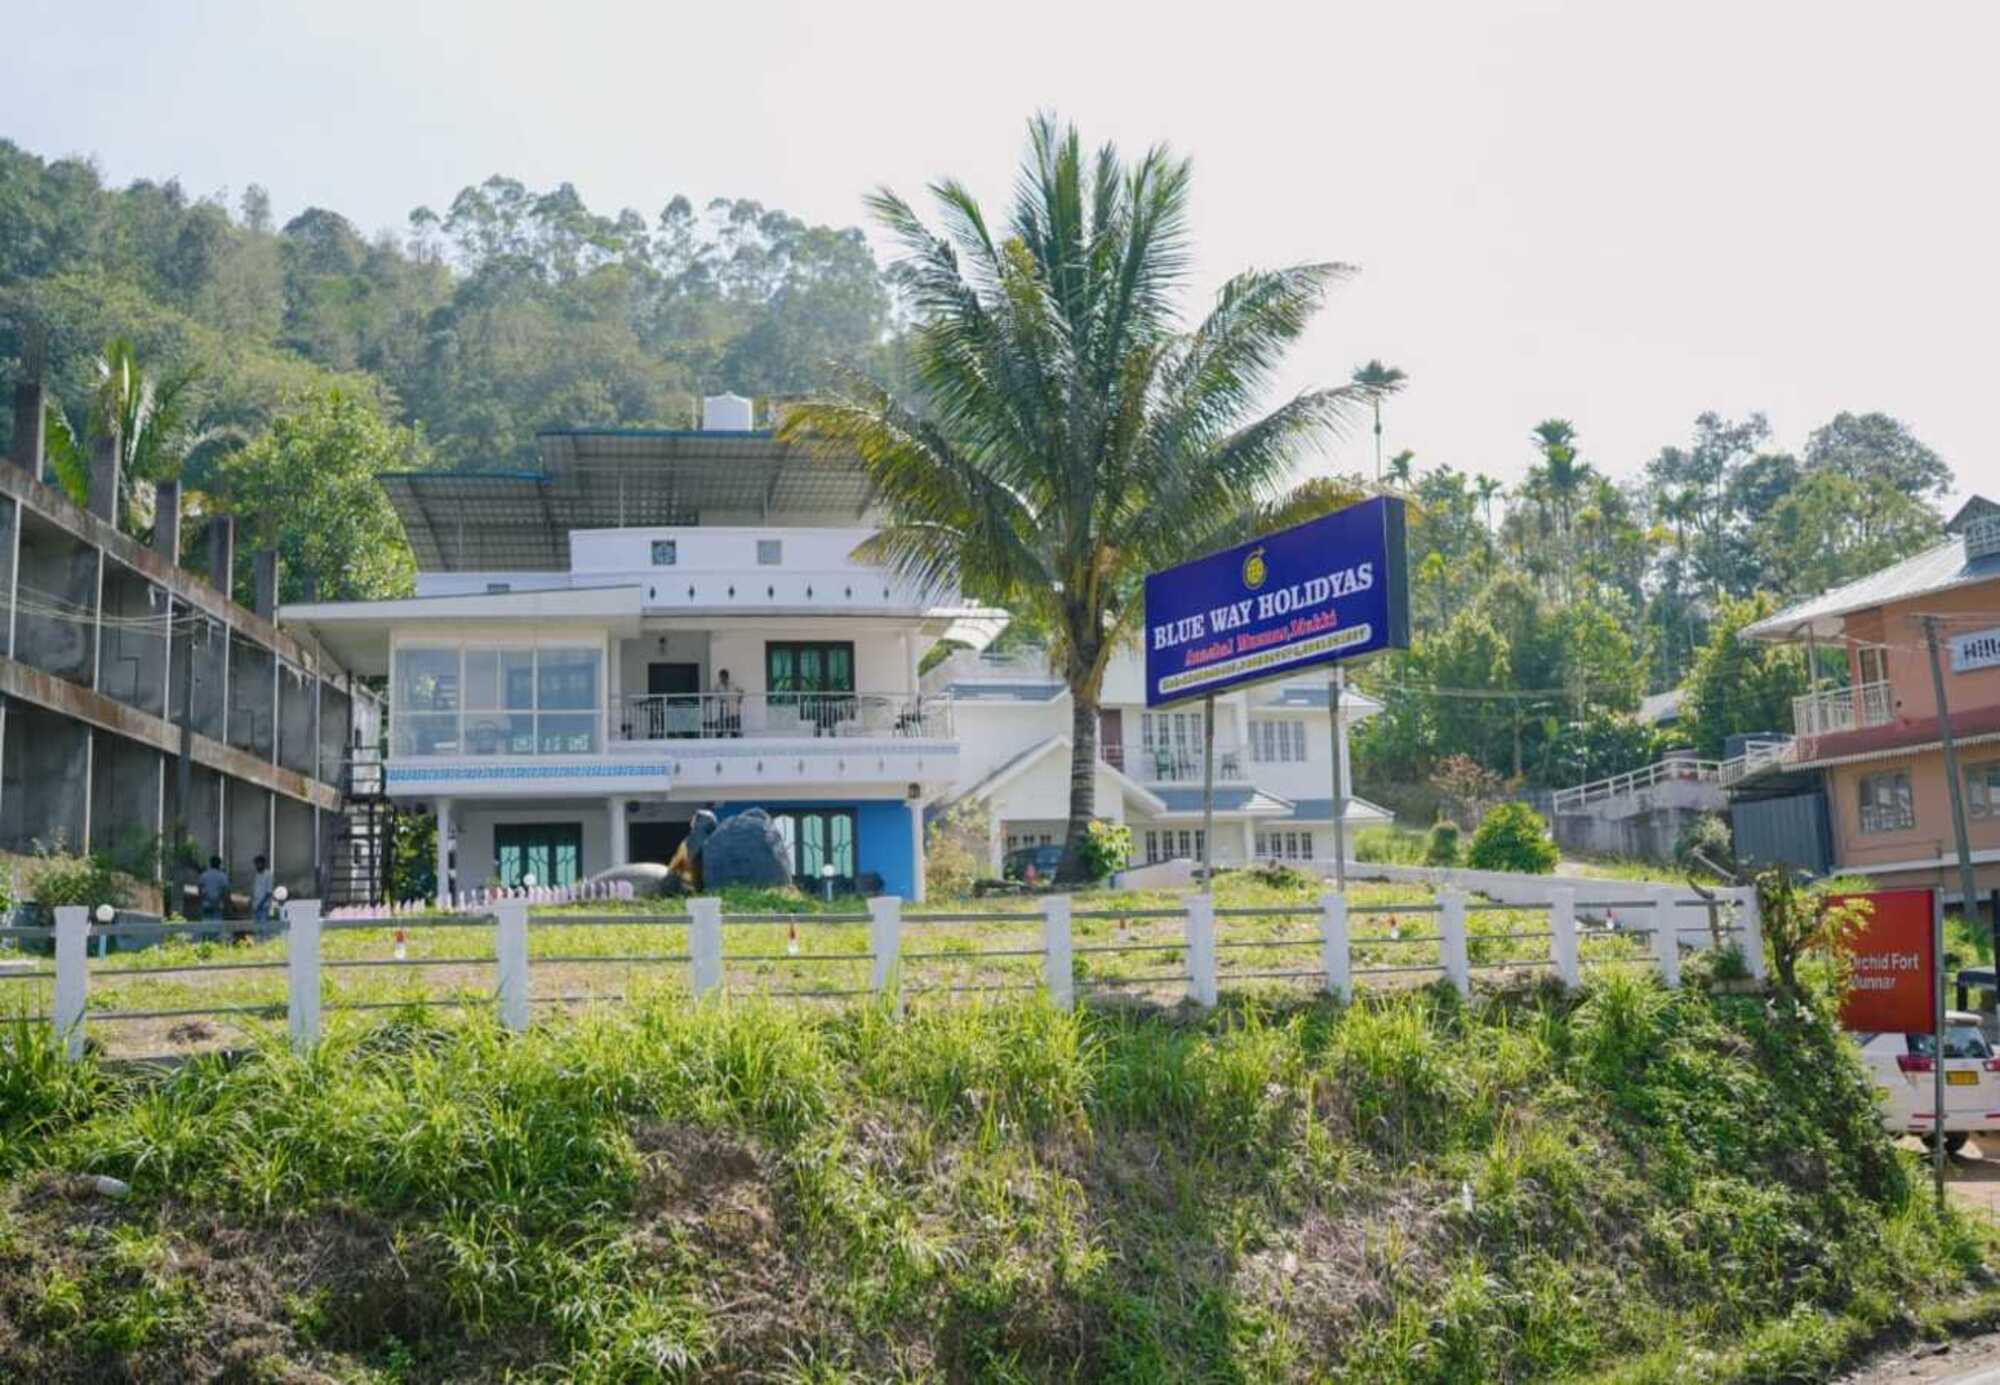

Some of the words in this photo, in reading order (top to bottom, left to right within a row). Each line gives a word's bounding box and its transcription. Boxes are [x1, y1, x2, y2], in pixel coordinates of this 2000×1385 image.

[1154, 614, 1205, 650] BLUE
[1210, 601, 1253, 634] WAY
[1257, 563, 1373, 619] HOLIDYAS
[1891, 952, 1920, 970] Fort
